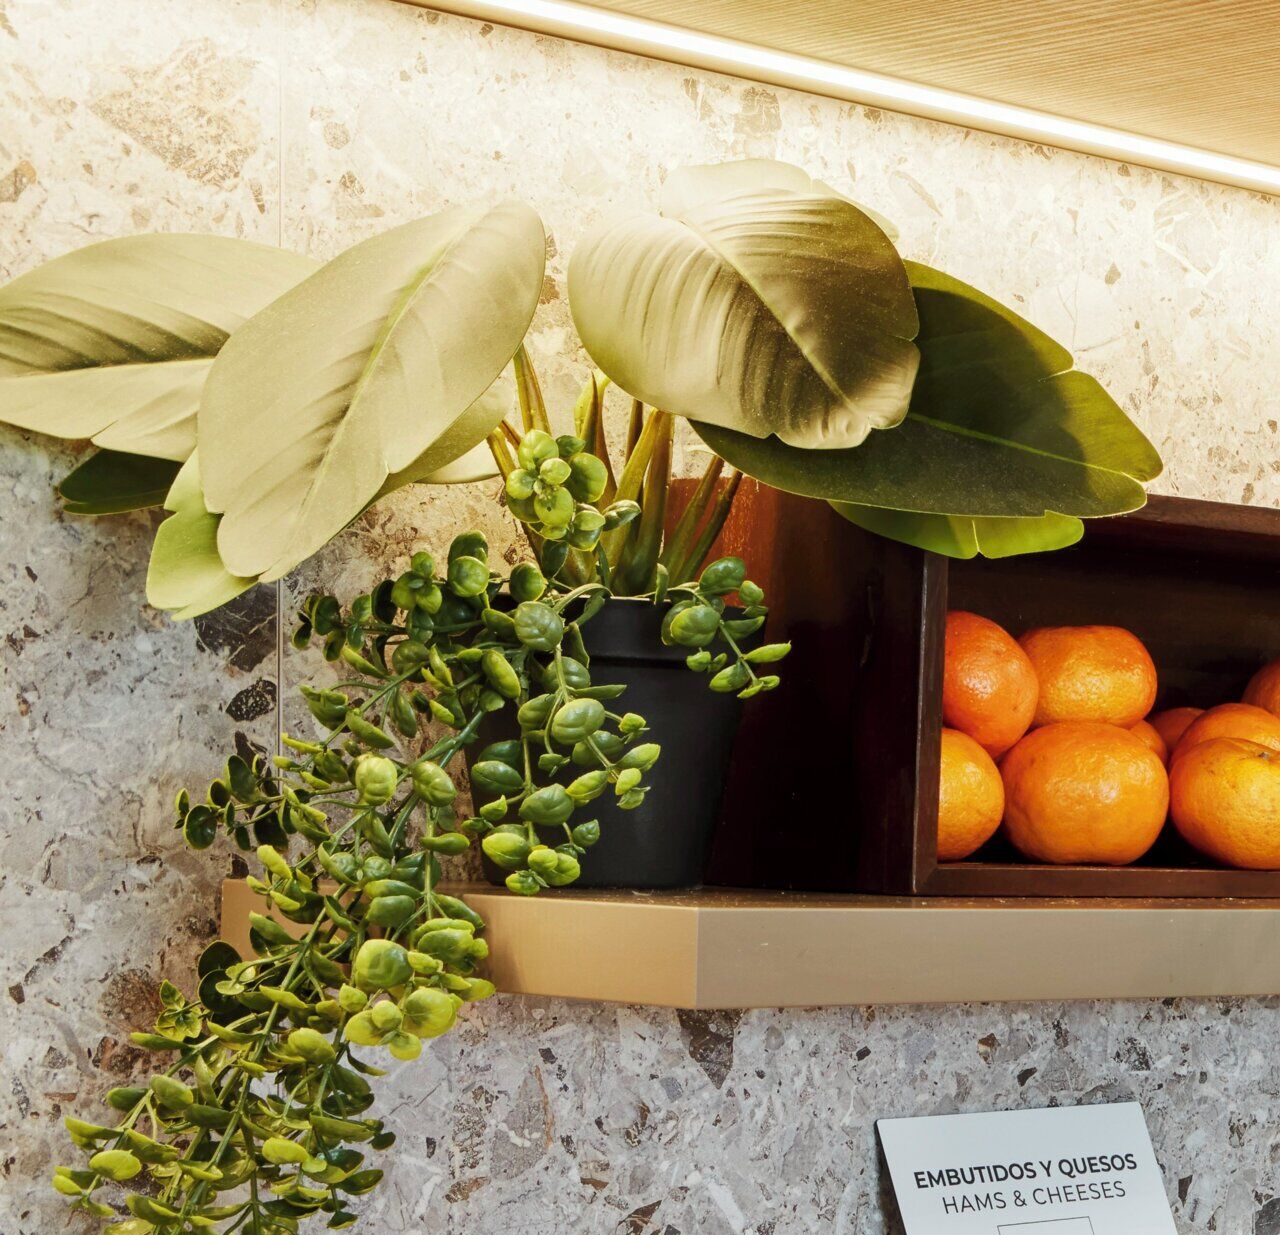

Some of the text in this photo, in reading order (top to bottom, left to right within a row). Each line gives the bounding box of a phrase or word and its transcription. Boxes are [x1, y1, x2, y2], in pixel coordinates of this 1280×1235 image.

[913, 1153, 1138, 1189] EMBUTIDOS Y QUESOS
[942, 1181, 1127, 1215] HAMS & CHEESES
